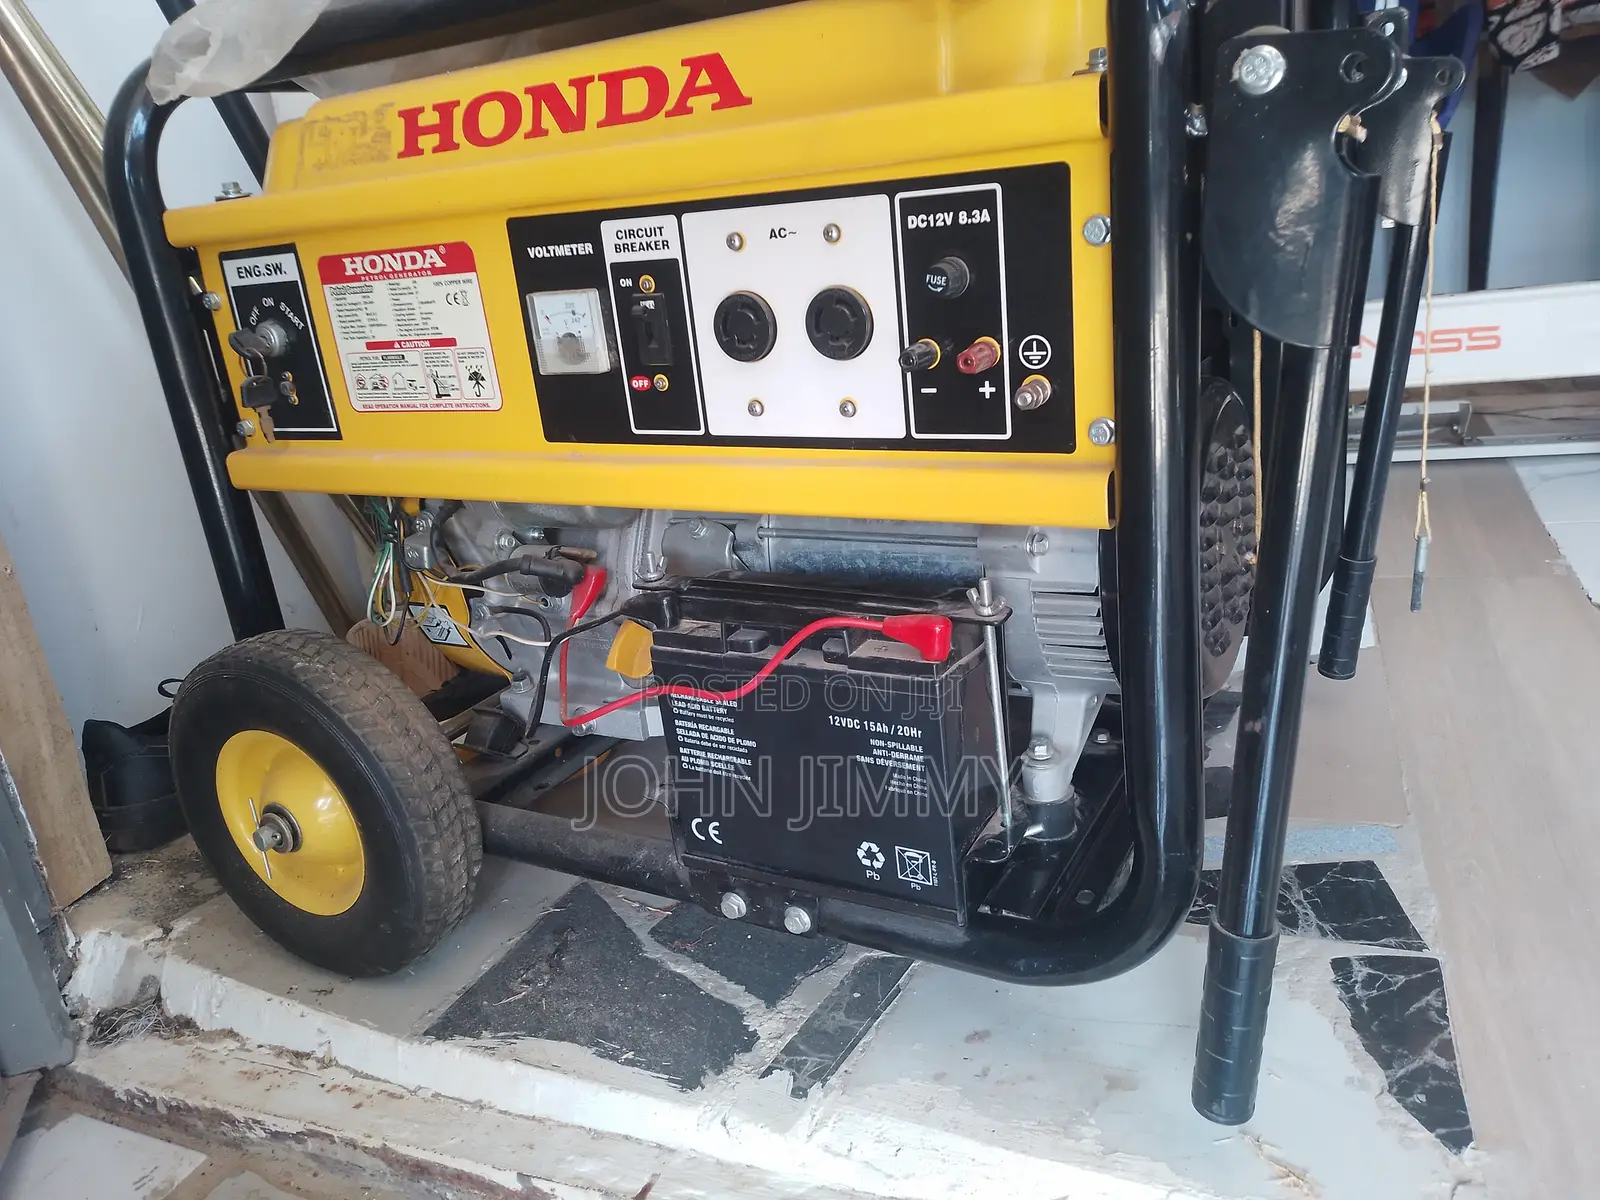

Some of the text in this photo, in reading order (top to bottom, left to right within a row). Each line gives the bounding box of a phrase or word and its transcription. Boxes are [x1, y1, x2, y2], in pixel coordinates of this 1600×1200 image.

[397, 52, 752, 159] HONDA
[908, 209, 991, 229] DC12V 8.3A
[616, 226, 664, 240] CIRCUIT
[527, 242, 594, 259] VOLTMETER
[614, 240, 670, 254] BREAKER
[236, 262, 287, 279] ENG.SW.
[360, 270, 432, 282] PETROL GENERATOR
[619, 278, 633, 288] ON
[926, 274, 947, 286] FUSE
[262, 297, 275, 307] ON
[250, 305, 260, 325] OFF
[280, 302, 305, 330] START
[632, 379, 649, 388] OFF
[688, 703, 700, 711] ACID
[702, 705, 727, 714] BATTERY
[698, 724, 735, 735] RECARGABLE
[828, 714, 861, 729] 12VDC
[863, 720, 889, 734] 15Ah
[896, 725, 923, 738] 20Hr
[676, 728, 700, 738] SELLADA
[728, 736, 735, 744] DE
[736, 738, 757, 748] PLOMO
[869, 738, 924, 753] NON-SPILLABLE
[679, 747, 752, 766] BATTERIE RECHARGEABLE
[872, 749, 924, 763] ANTI-DERRAME
[856, 755, 925, 772] SANS DÉVERSEMENT
[866, 870, 880, 881] Pb
[911, 882, 921, 891] Pb
